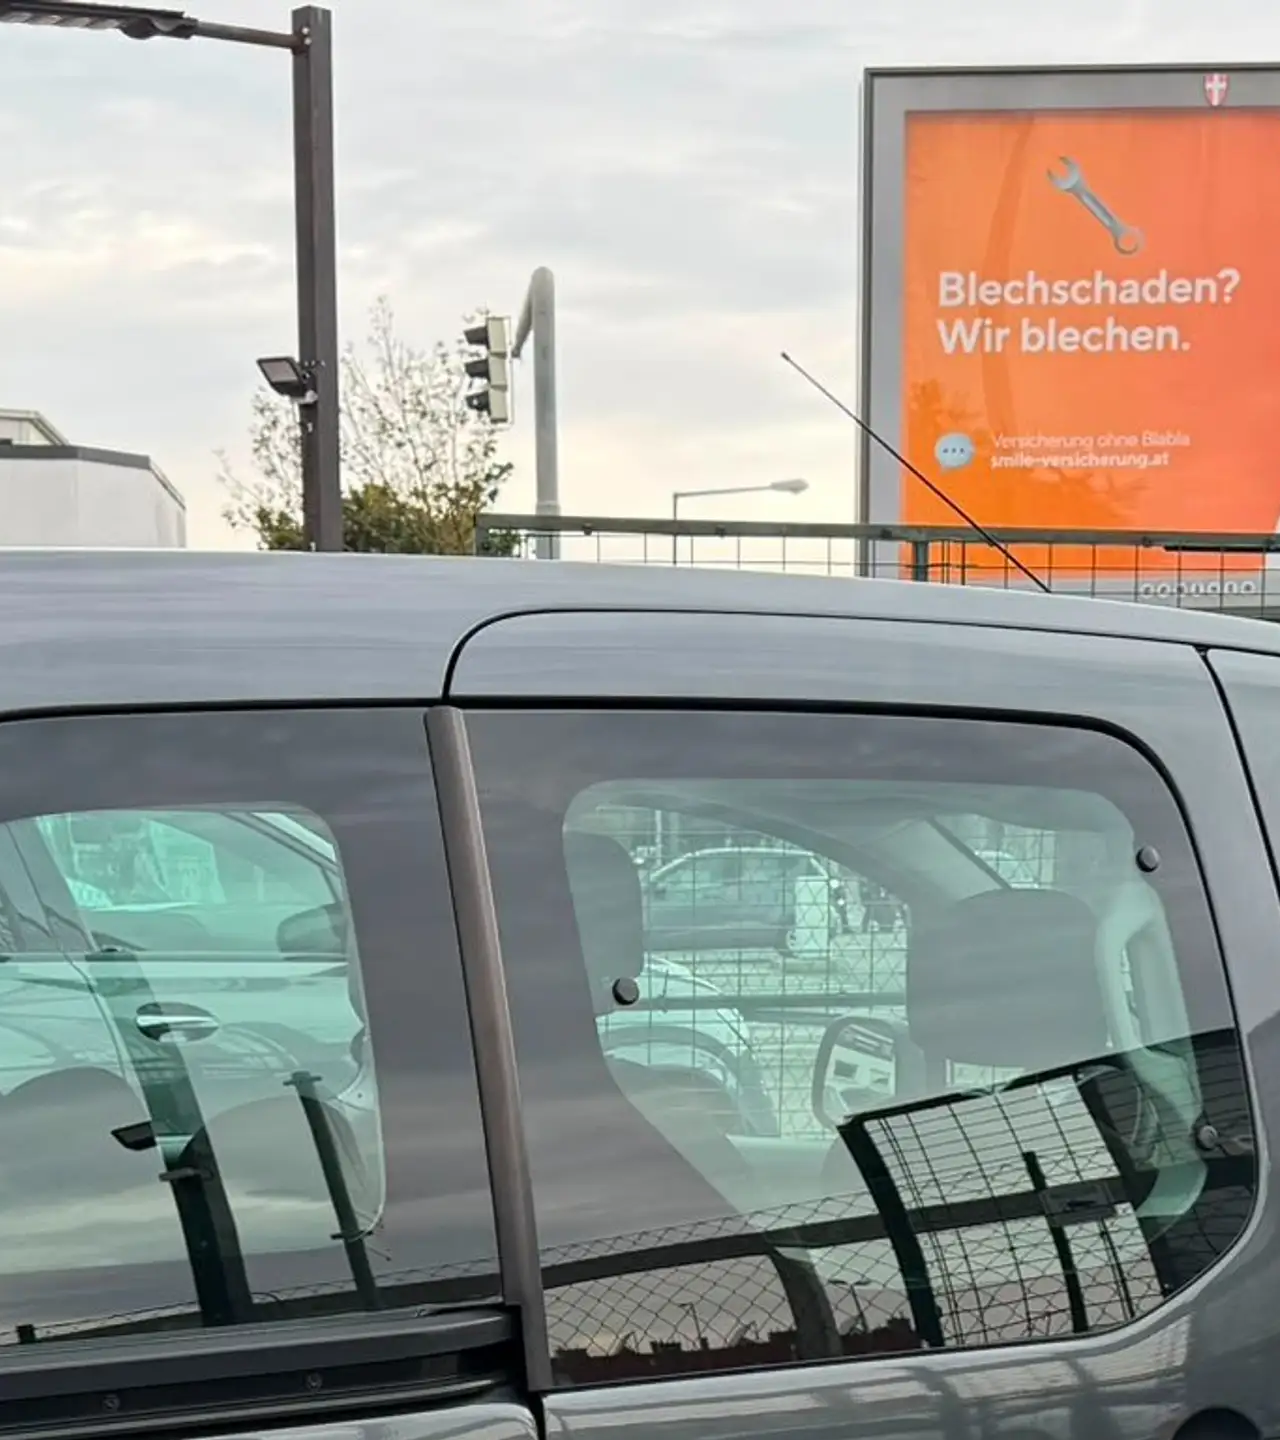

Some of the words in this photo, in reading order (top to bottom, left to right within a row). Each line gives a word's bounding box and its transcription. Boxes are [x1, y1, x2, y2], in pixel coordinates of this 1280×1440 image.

[938, 267, 1241, 307] Blechschaden?
[936, 318, 1011, 353] Wir
[1021, 316, 1191, 352] blechen.
[992, 433, 1094, 453] Versicherung
[1096, 433, 1139, 447] ohne
[1141, 431, 1191, 446] Blabla
[991, 452, 1169, 470] smile-versicherung.at
